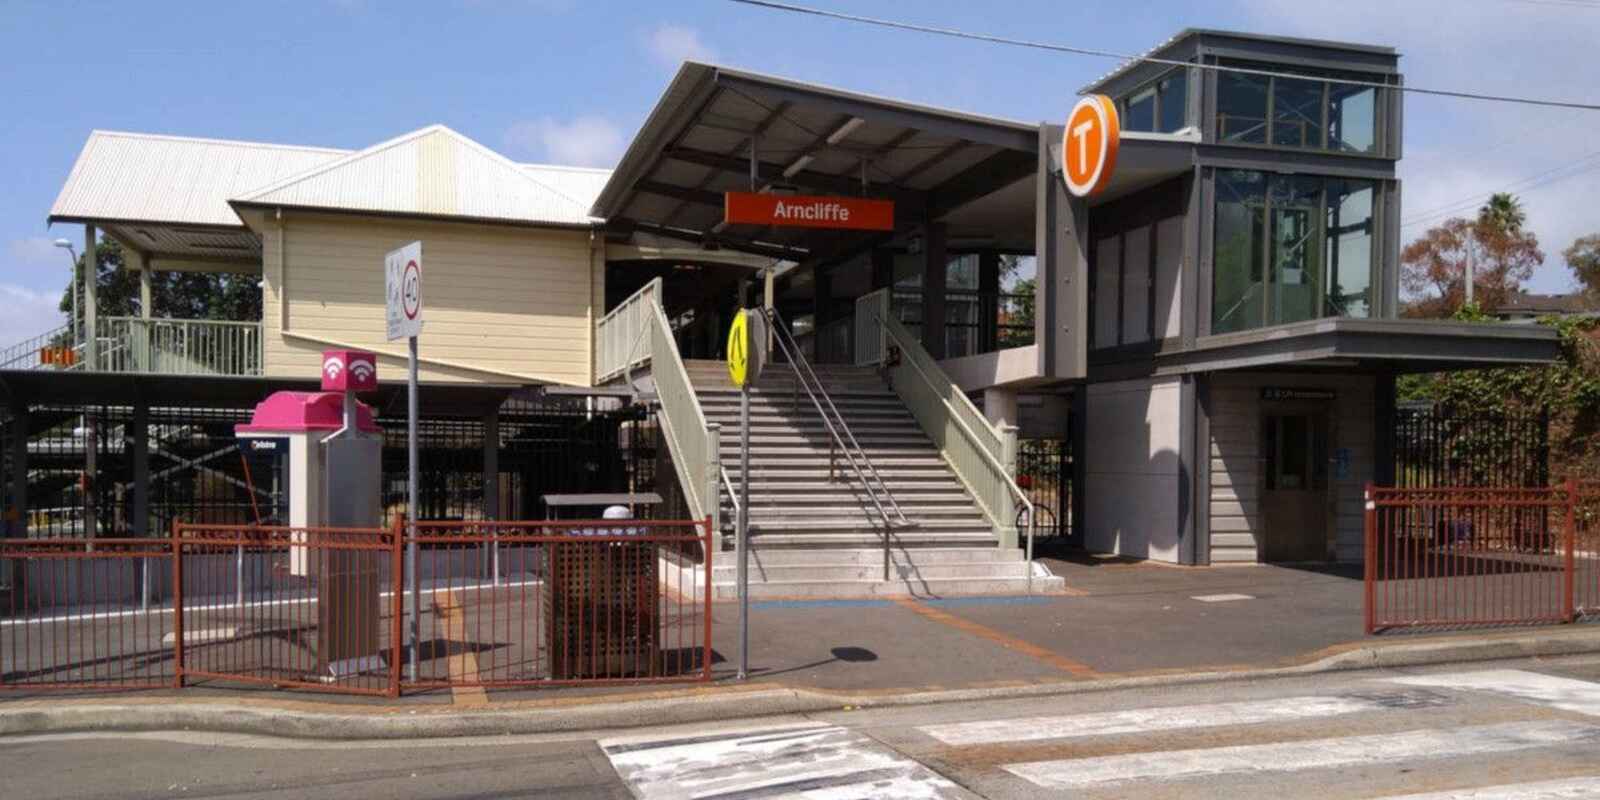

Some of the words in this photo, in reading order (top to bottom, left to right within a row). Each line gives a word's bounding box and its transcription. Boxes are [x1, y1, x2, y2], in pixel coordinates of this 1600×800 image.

[1073, 119, 1094, 175] T
[773, 201, 849, 221] Arncliffe
[405, 275, 418, 302] 40
